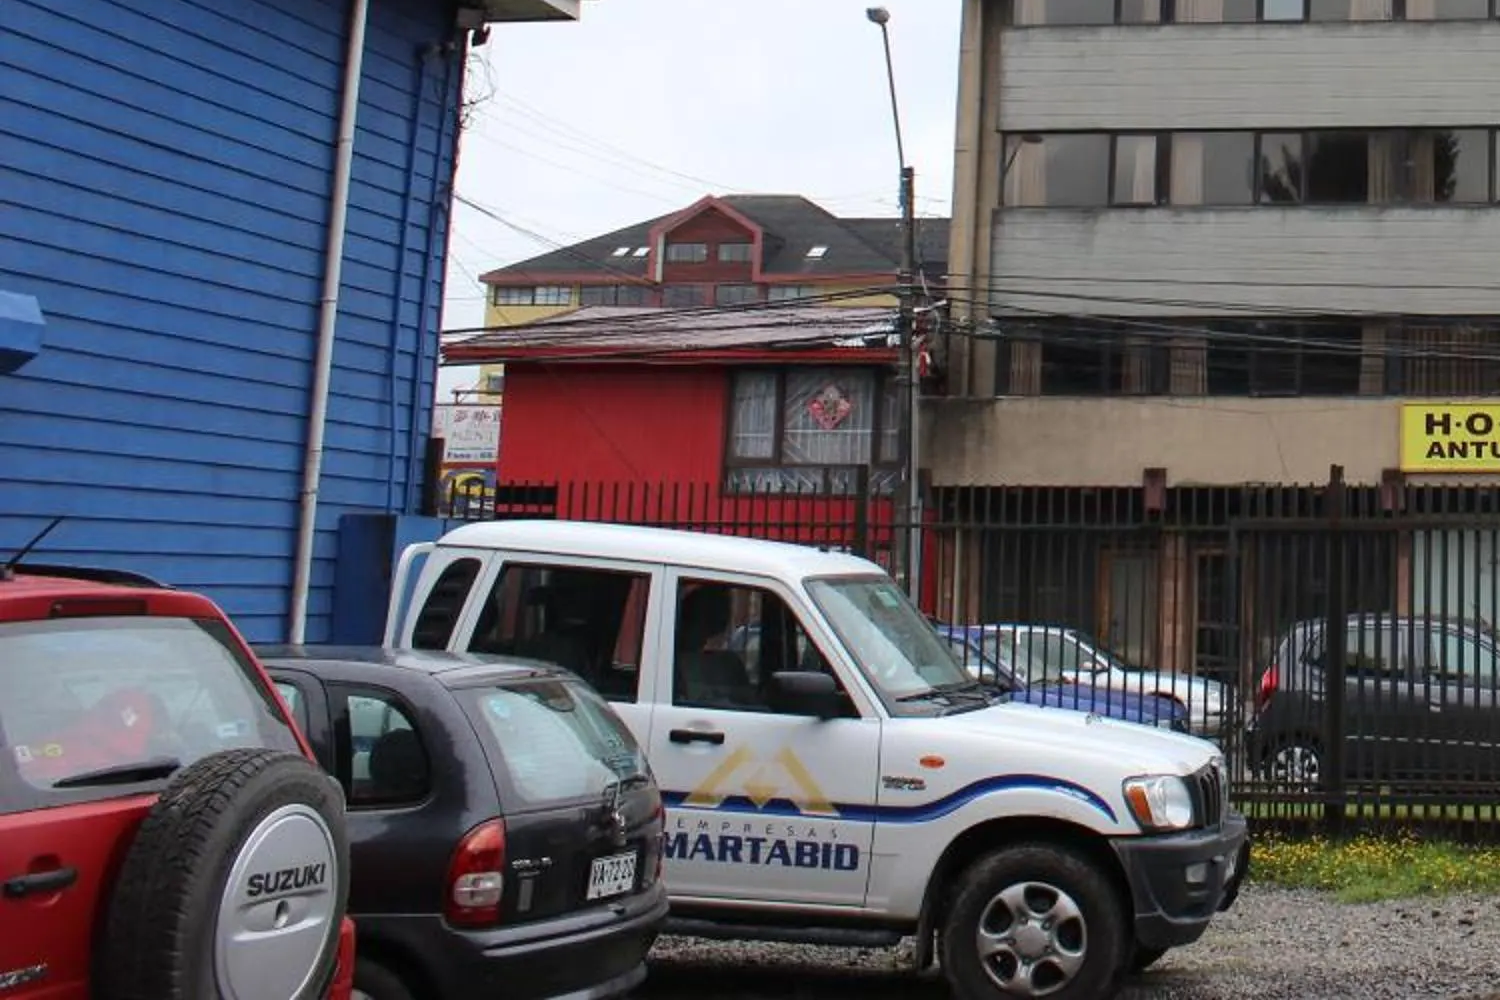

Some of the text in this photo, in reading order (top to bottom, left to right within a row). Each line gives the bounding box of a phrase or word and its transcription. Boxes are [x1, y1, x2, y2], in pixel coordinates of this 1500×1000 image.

[677, 817, 841, 839] EMPRESAS
[664, 831, 860, 871] MARTABID
[247, 862, 326, 897] SUZUKI
